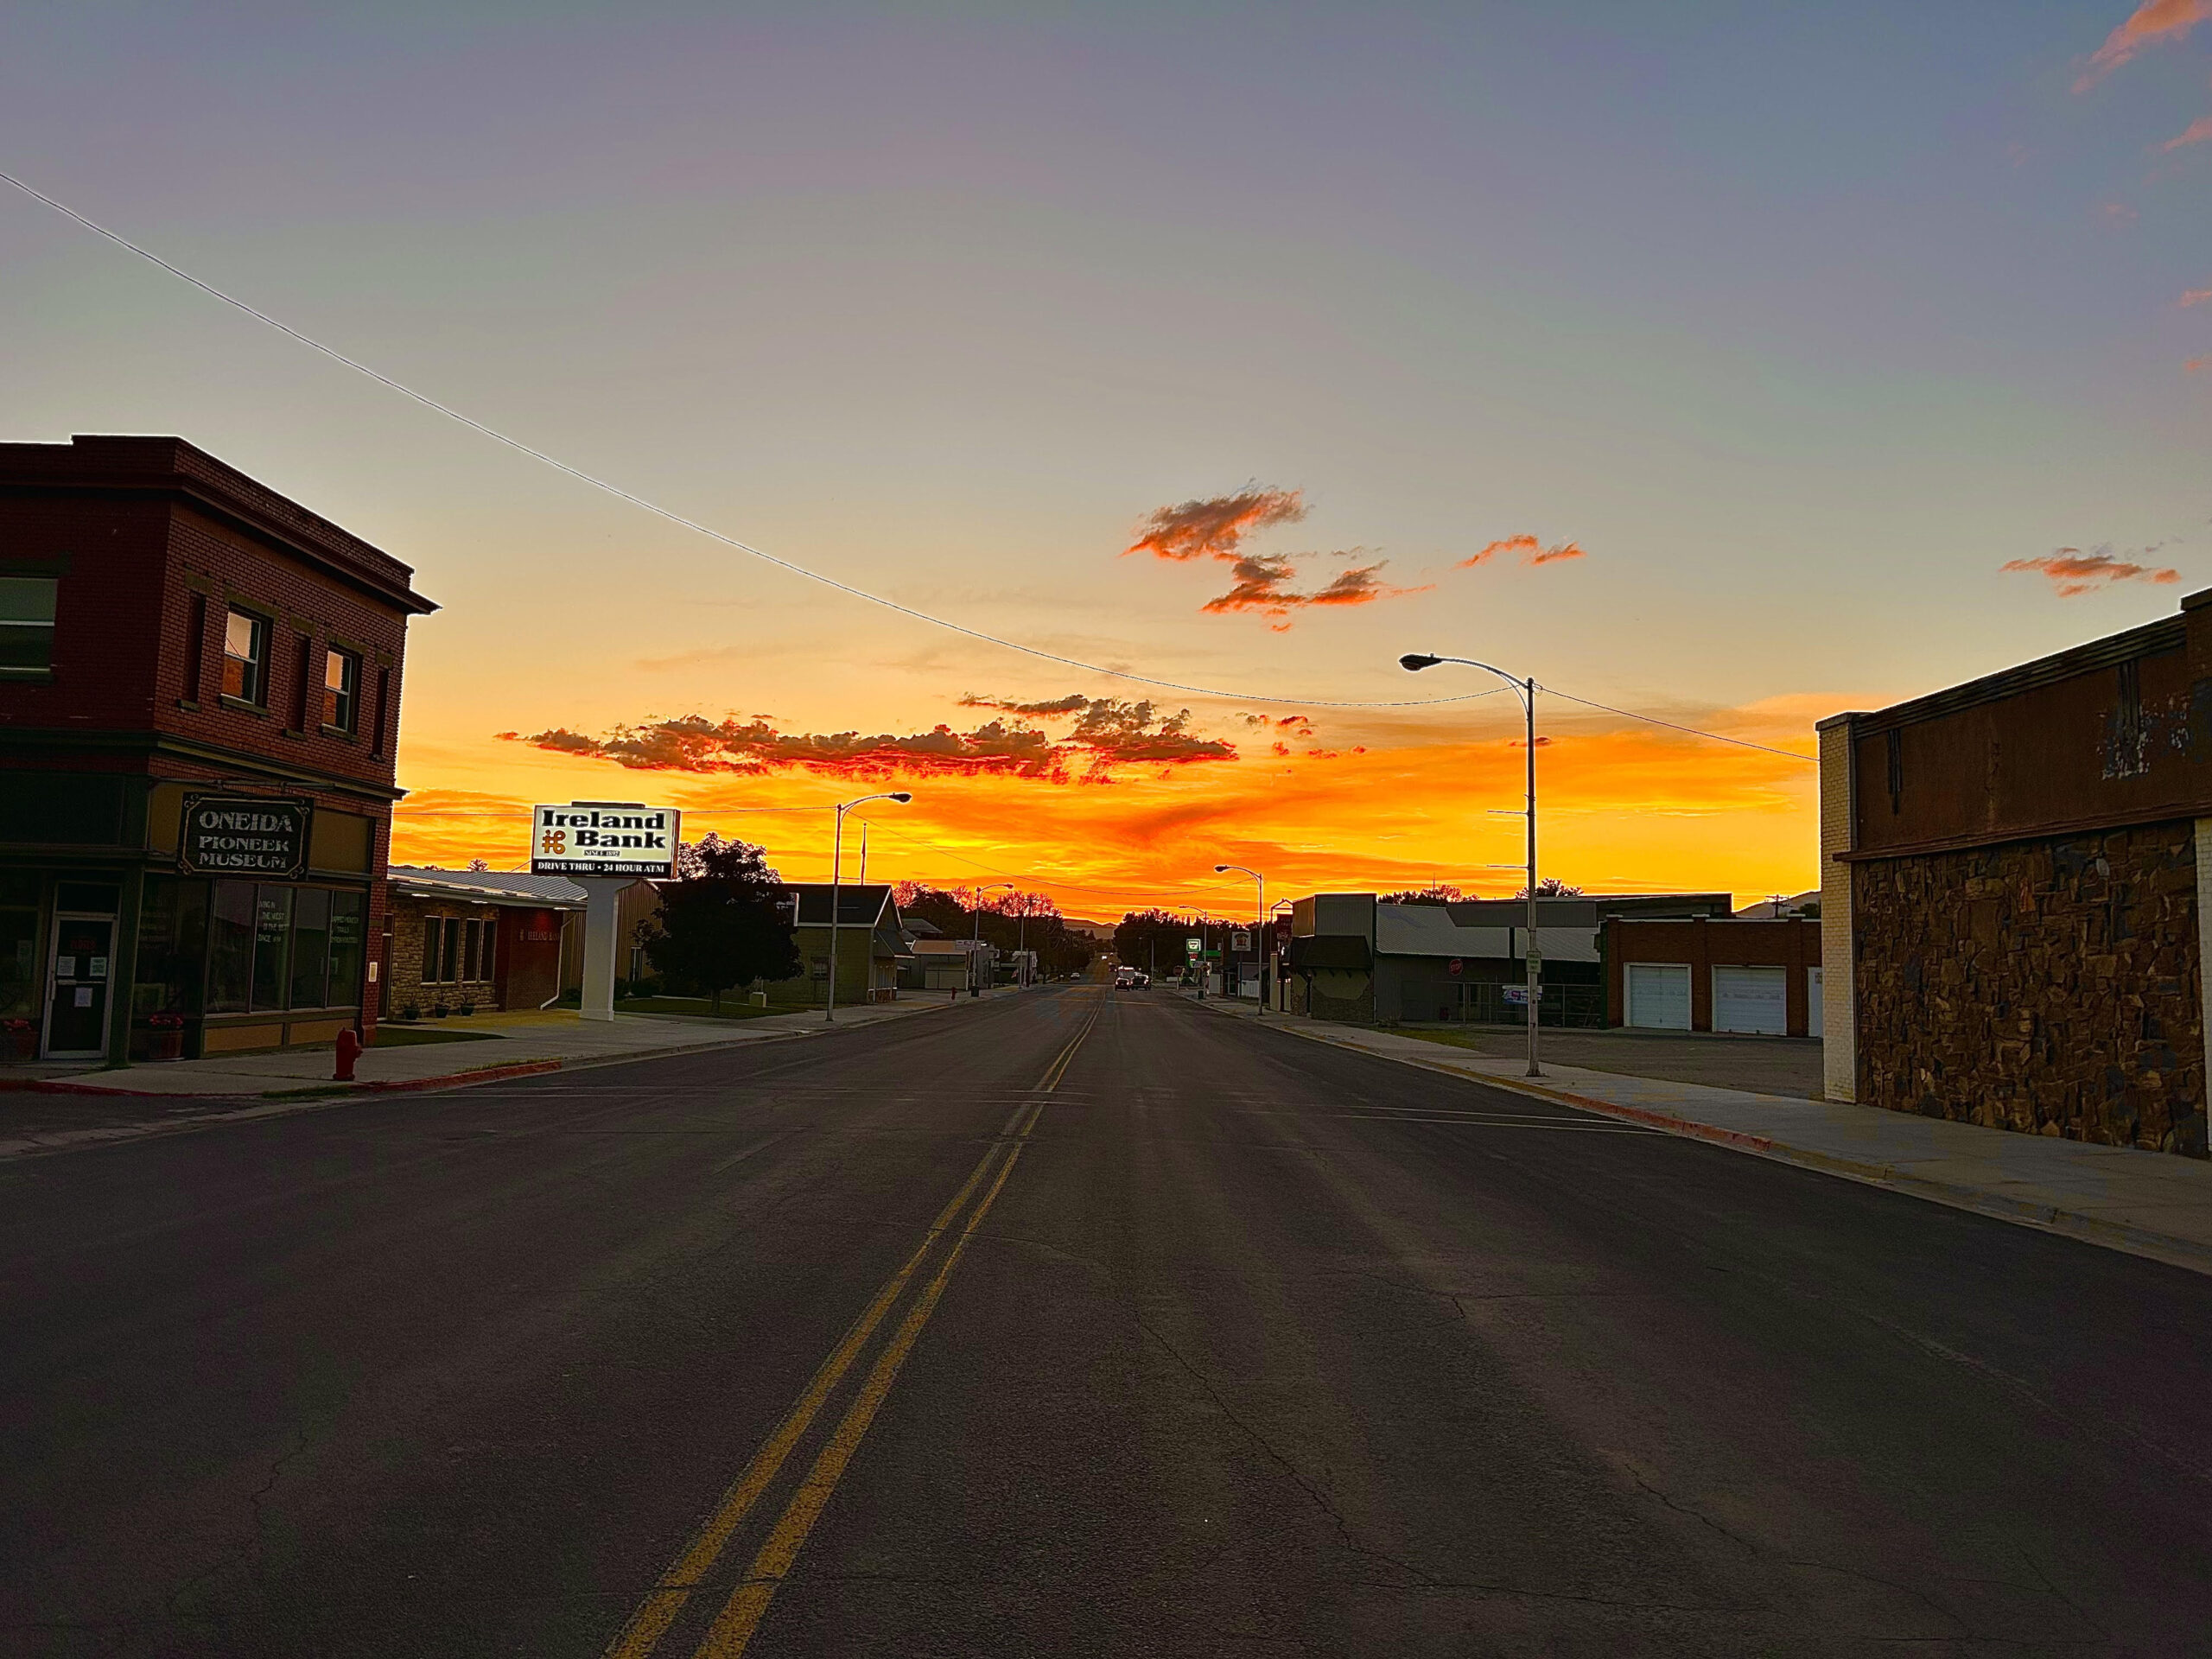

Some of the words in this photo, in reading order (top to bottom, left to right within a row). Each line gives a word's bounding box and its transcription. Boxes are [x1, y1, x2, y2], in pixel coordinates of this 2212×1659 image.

[199, 810, 293, 832] ONEIDA
[542, 810, 665, 830] Ireland
[198, 836, 289, 852] PIONEER
[575, 830, 666, 849] Bank
[199, 852, 287, 868] MUSEUM
[537, 861, 568, 871] DRIVE
[1450, 963, 1462, 972] STOP
